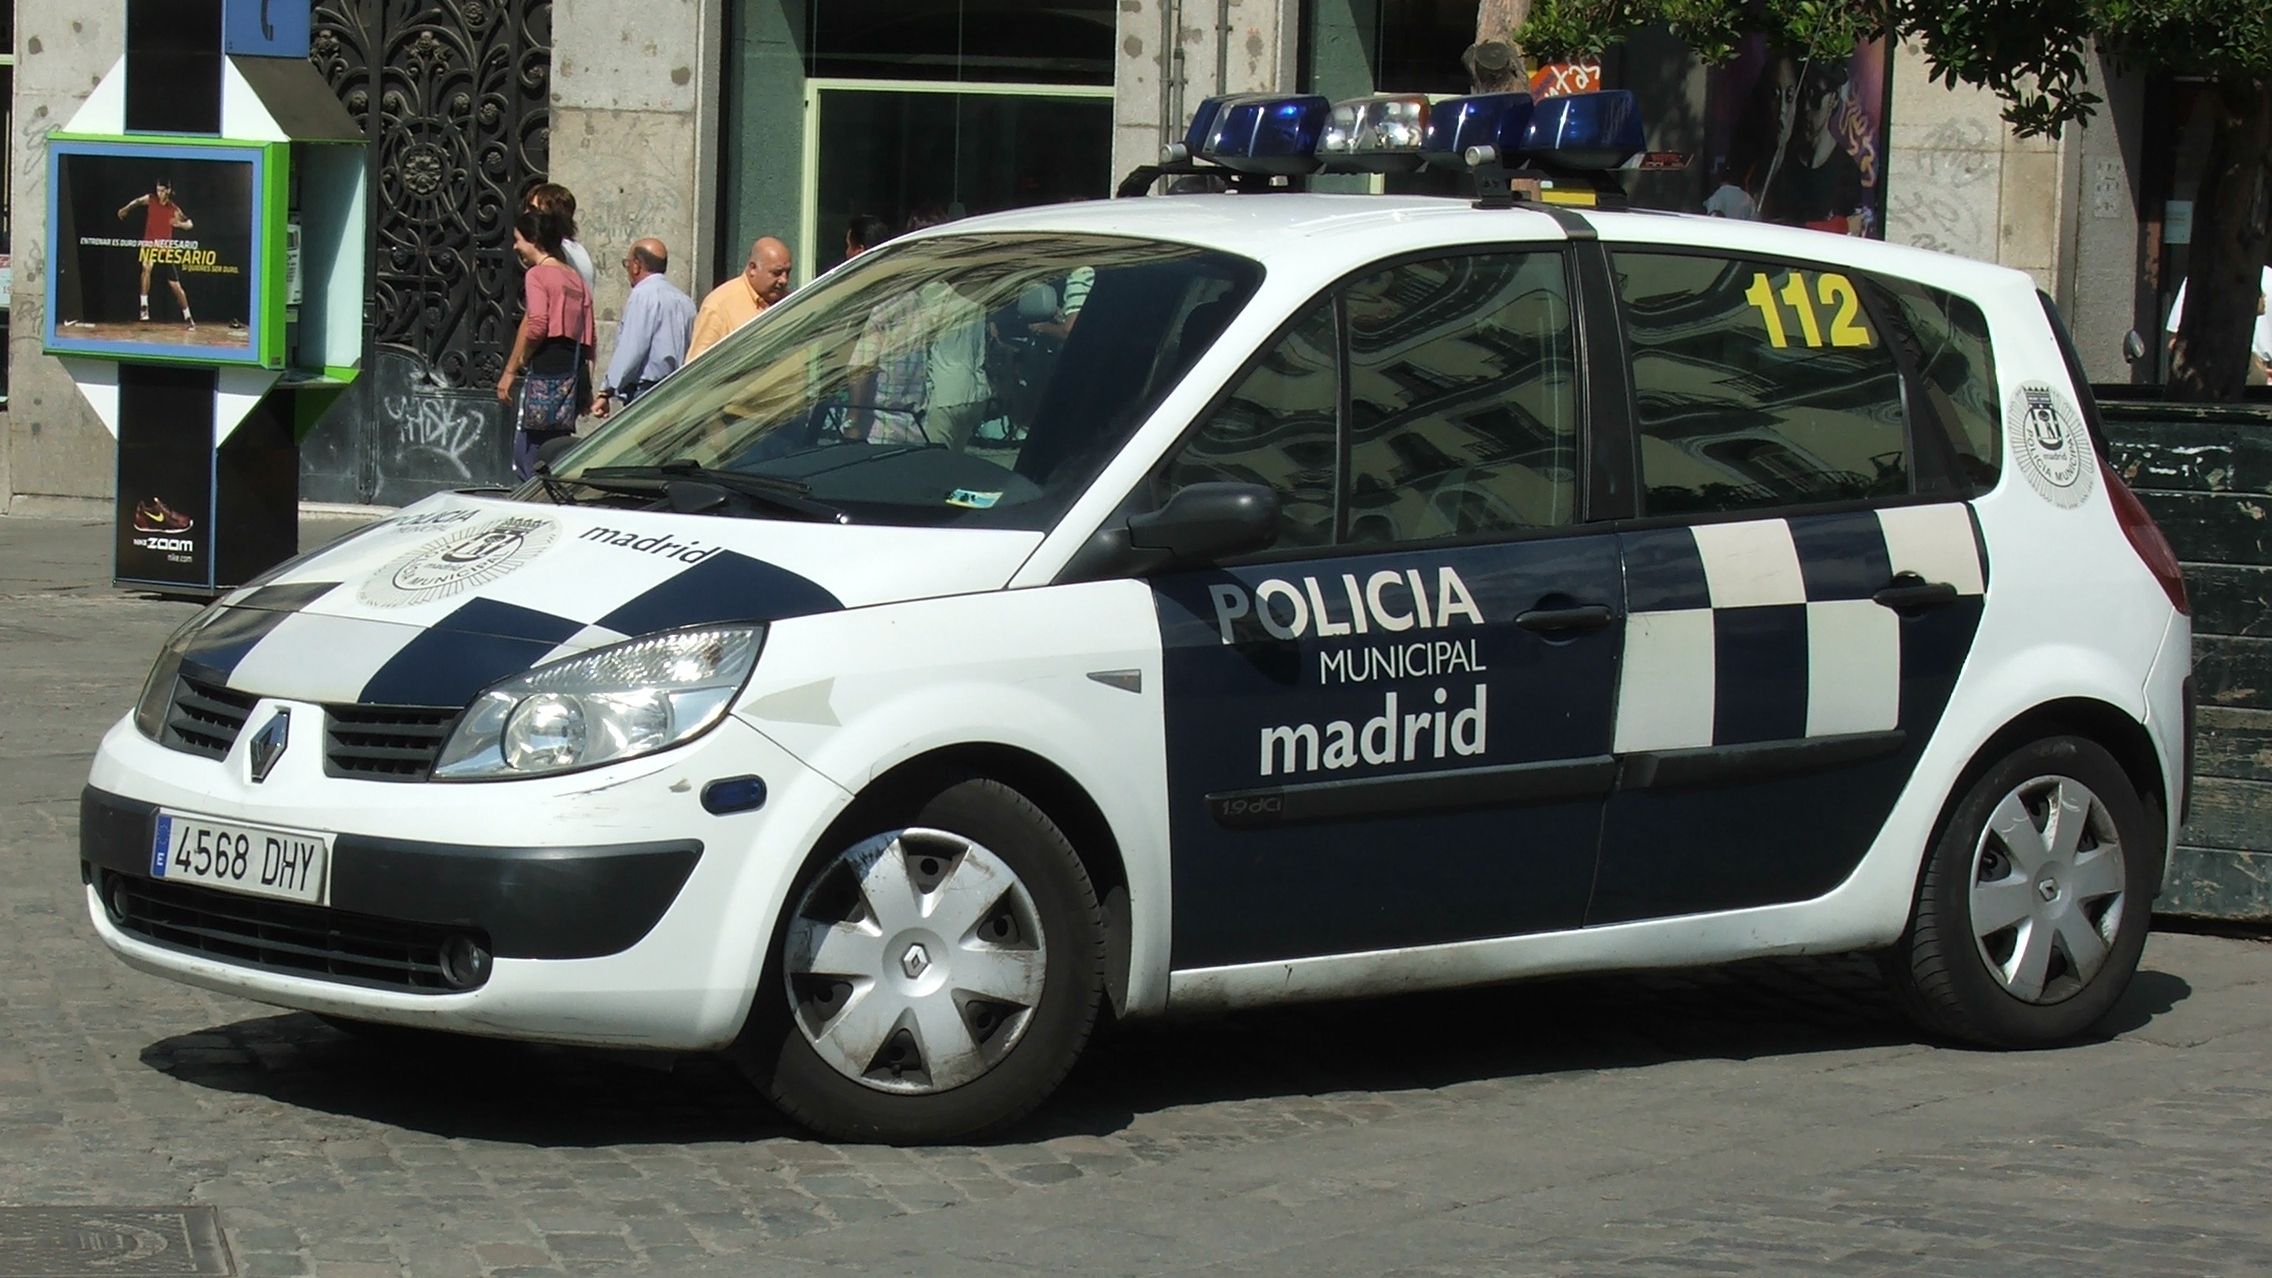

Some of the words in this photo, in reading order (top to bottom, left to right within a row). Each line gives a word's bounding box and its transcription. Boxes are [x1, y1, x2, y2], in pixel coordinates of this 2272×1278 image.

[139, 248, 216, 266] NECESARIO
[153, 239, 199, 250] NECESARIO
[1745, 273, 1871, 348] 112
[579, 525, 721, 565] madrid
[1208, 566, 1486, 645] POLICIA
[1320, 639, 1487, 685] MUNICIPAL
[1260, 683, 1488, 777] madrid
[156, 852, 165, 867] E
[174, 826, 250, 881] 4568
[261, 837, 315, 892] DHY
